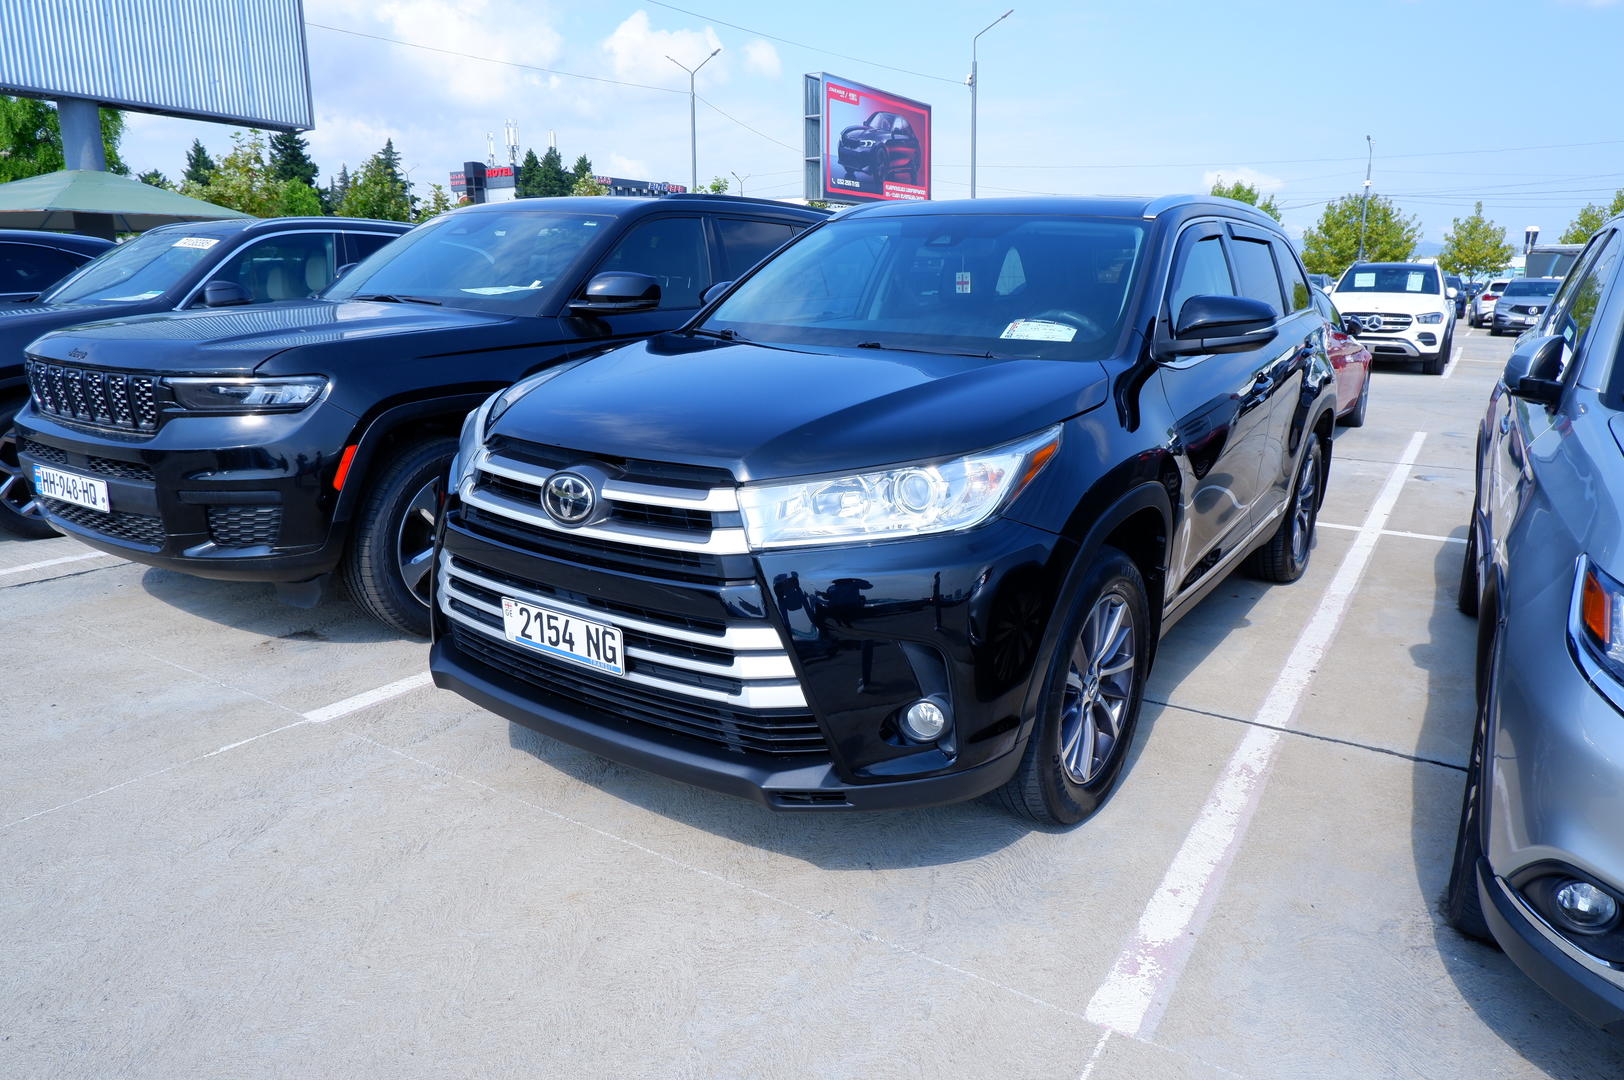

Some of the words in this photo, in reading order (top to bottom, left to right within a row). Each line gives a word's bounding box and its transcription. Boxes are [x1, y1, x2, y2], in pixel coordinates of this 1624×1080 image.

[486, 168, 513, 178] HOTEL
[42, 471, 97, 506] HH-948-HQ
[519, 607, 575, 652] 2154
[585, 625, 617, 664] NG
